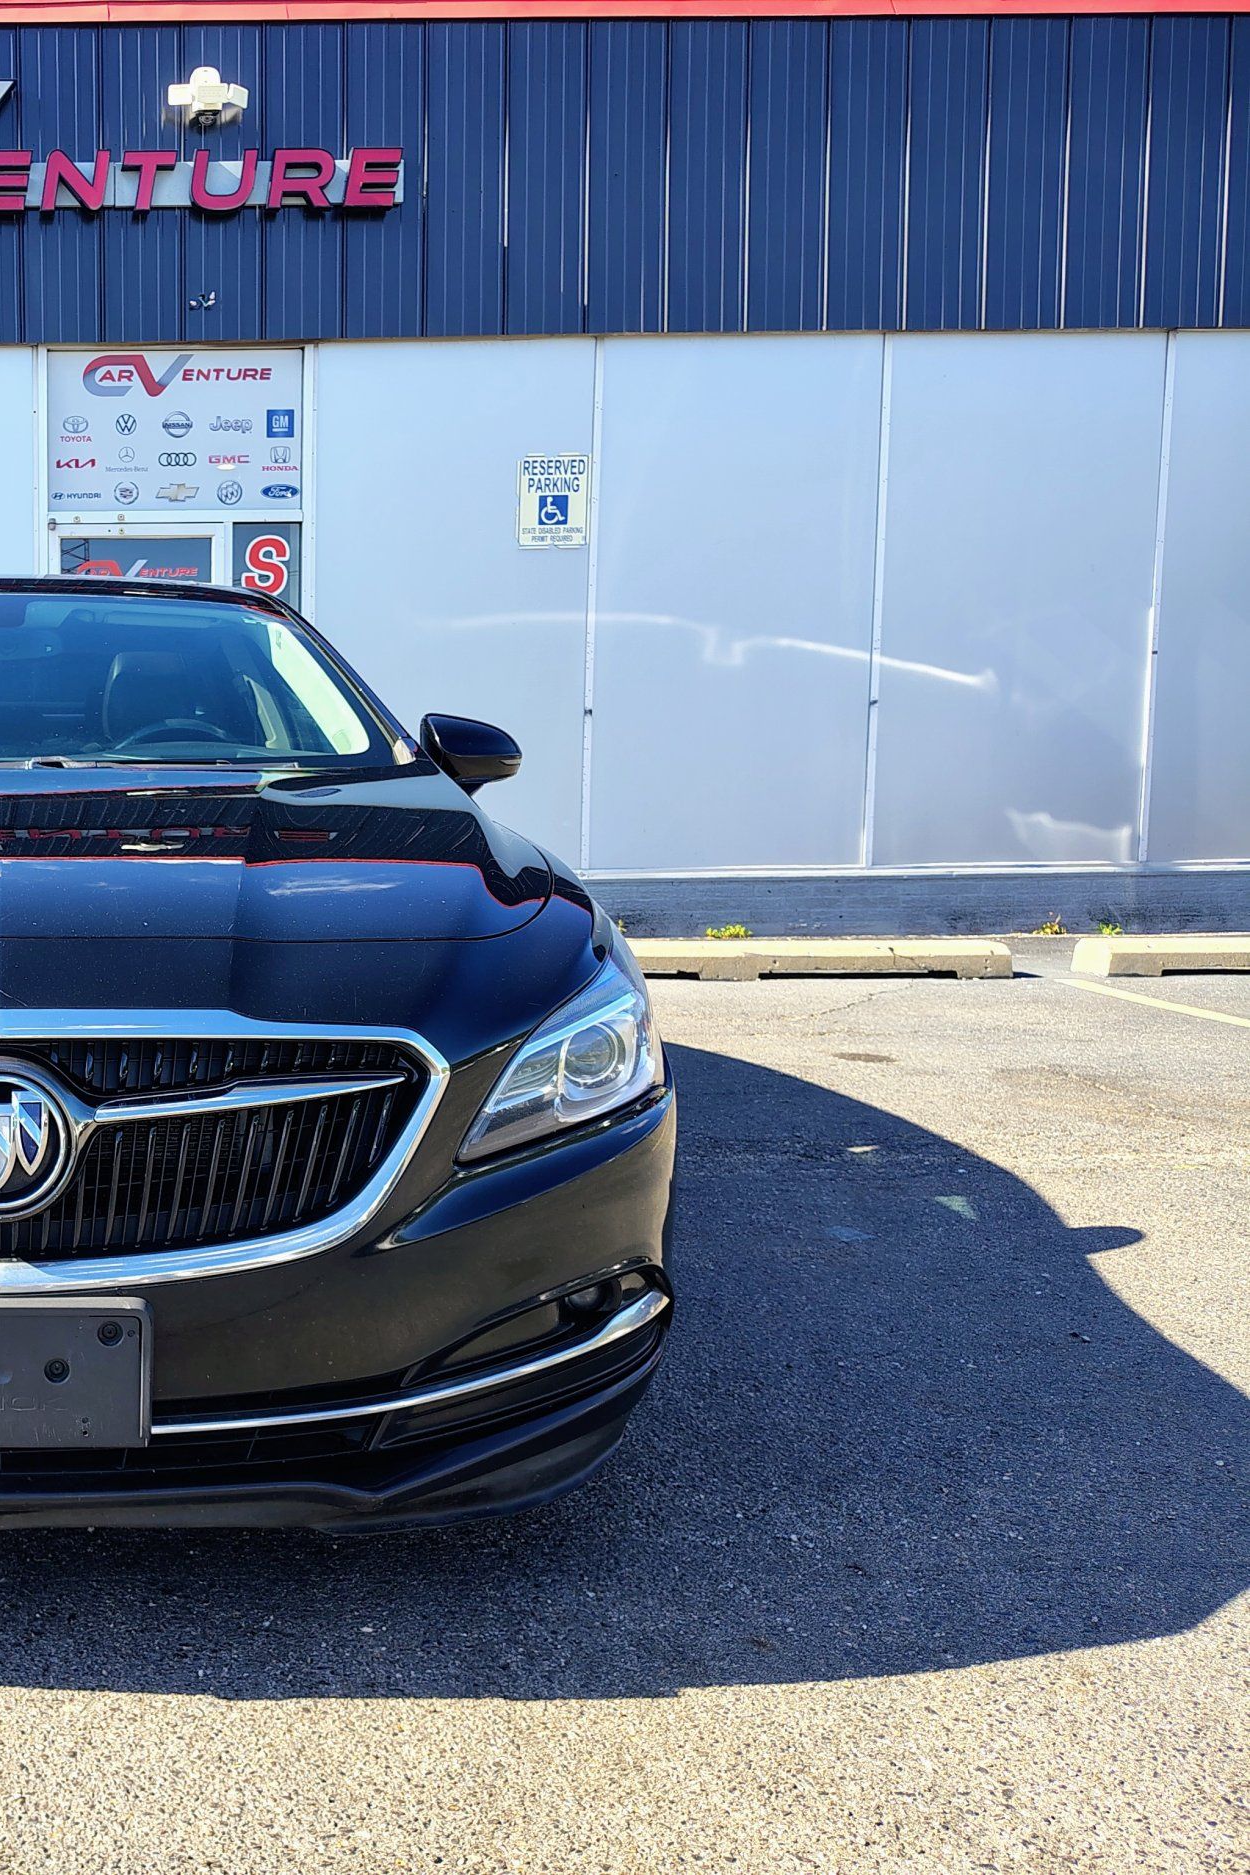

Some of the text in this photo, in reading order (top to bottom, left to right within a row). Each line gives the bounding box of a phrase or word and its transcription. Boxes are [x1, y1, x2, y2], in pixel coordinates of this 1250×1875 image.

[209, 416, 253, 433] Jeep
[272, 415, 289, 428] GM
[208, 455, 251, 464] GMC
[523, 459, 586, 476] RESERVED
[528, 477, 580, 493] PARKING
[243, 535, 290, 595] S
